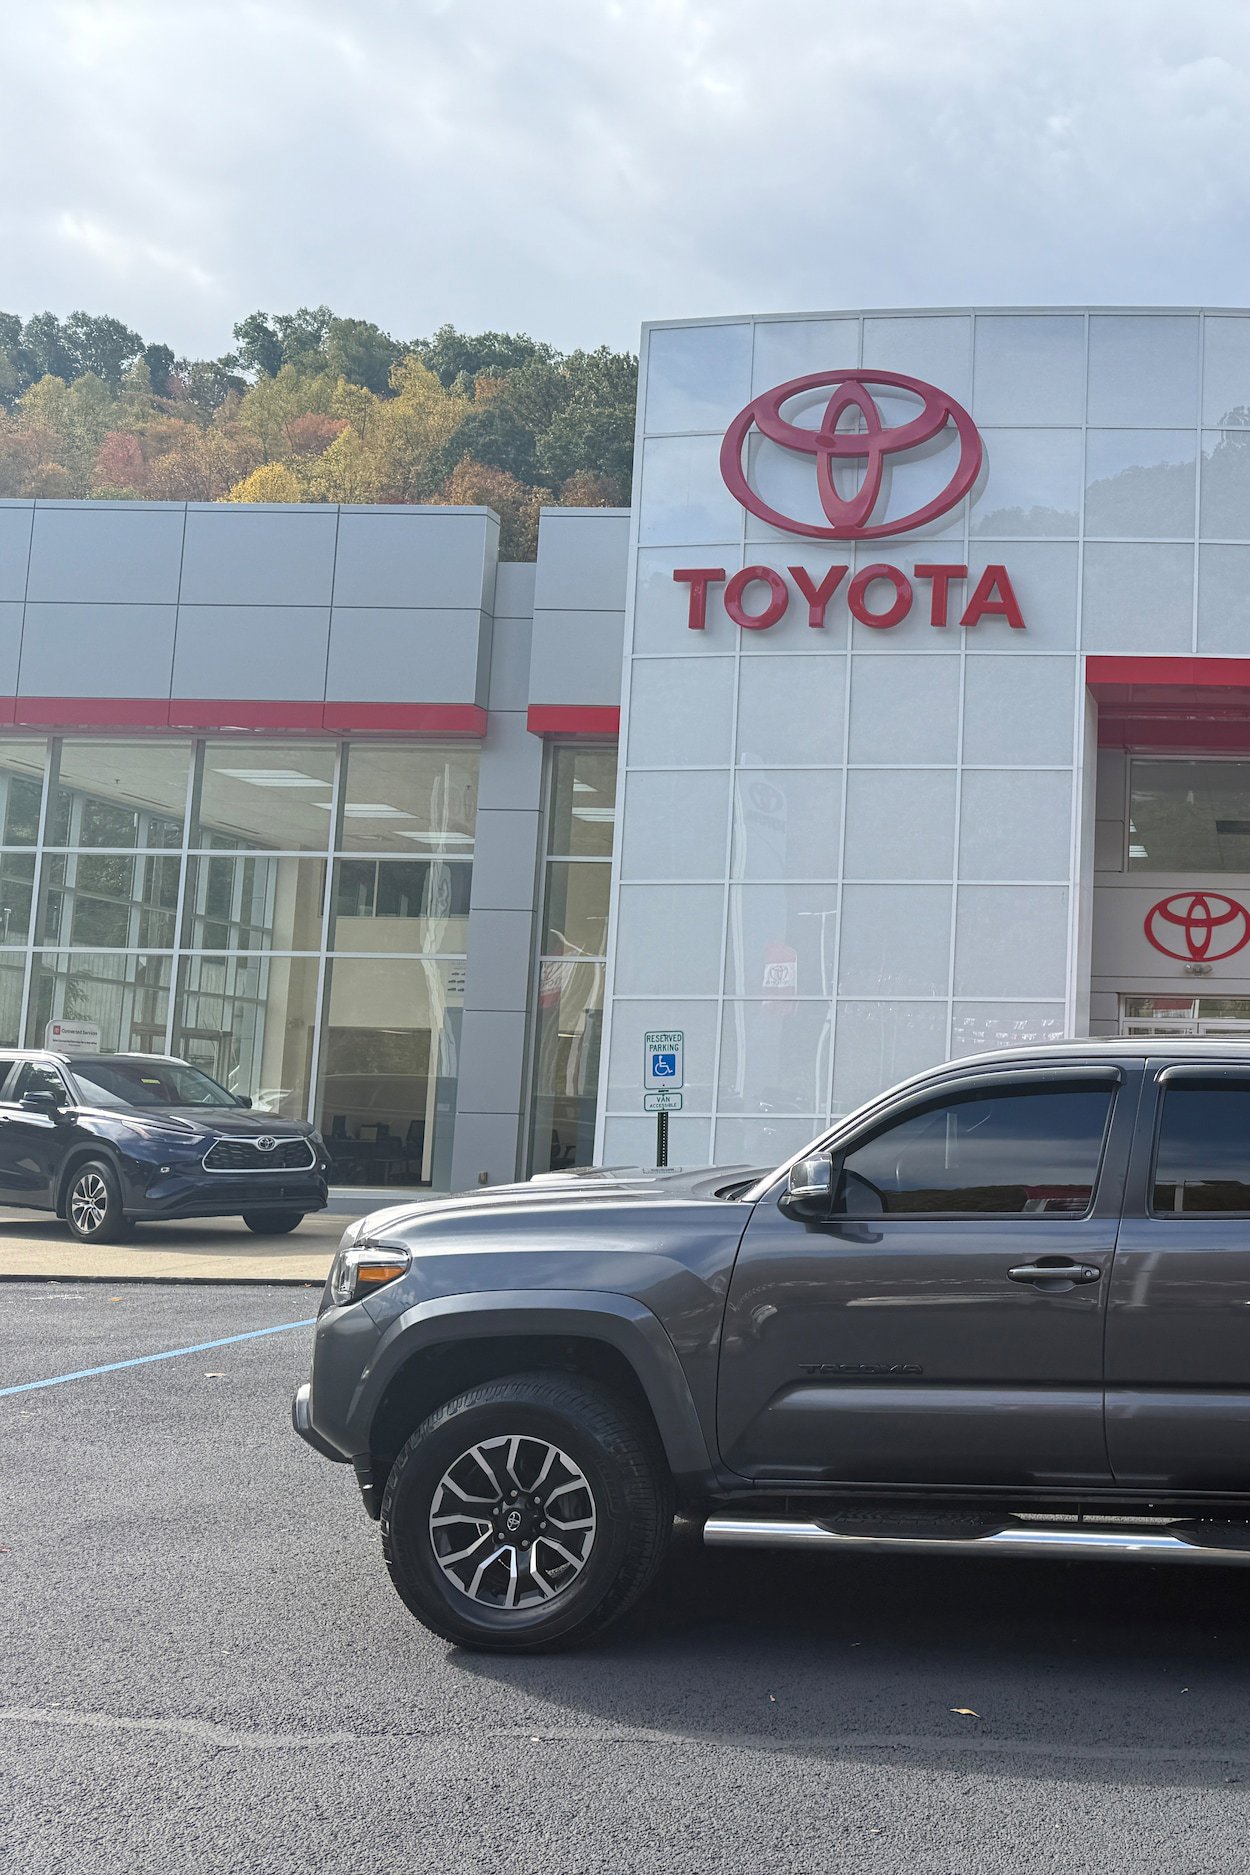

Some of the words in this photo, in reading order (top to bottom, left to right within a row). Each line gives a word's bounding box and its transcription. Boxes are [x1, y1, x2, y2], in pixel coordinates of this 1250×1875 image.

[673, 563, 1026, 630] TOYOTA
[647, 1034, 682, 1043] RESERVED
[649, 1044, 679, 1052] PARKING
